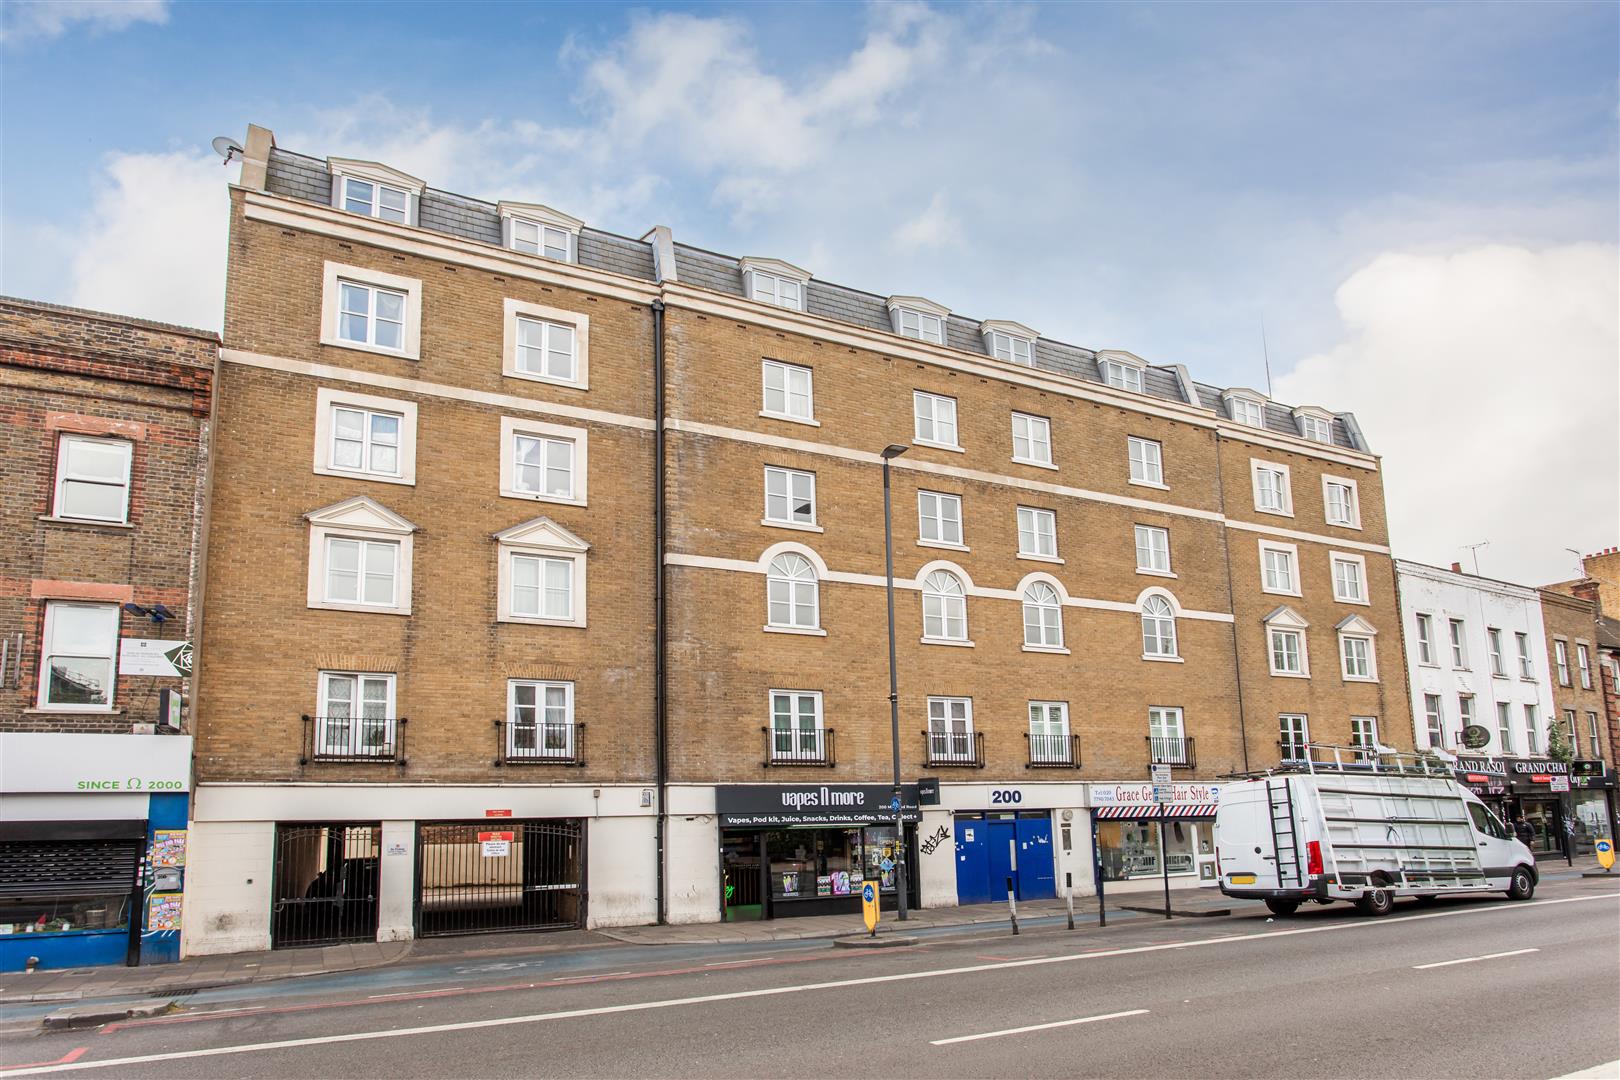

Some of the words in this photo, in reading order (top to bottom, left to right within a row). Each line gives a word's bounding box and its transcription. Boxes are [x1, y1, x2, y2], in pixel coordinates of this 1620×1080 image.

[1452, 760, 1478, 771] RAND
[1479, 760, 1506, 773] RASOI
[1515, 762, 1546, 773] GRAND
[1546, 763, 1568, 773] CHAI
[78, 781, 120, 789] SINCE
[148, 781, 182, 789] 2000
[830, 791, 865, 806] more
[992, 790, 1022, 803] 200
[1115, 785, 1140, 801] Grace
[1190, 785, 1209, 803] Style
[727, 817, 752, 825] Vapes,
[781, 815, 801, 823] Juice,
